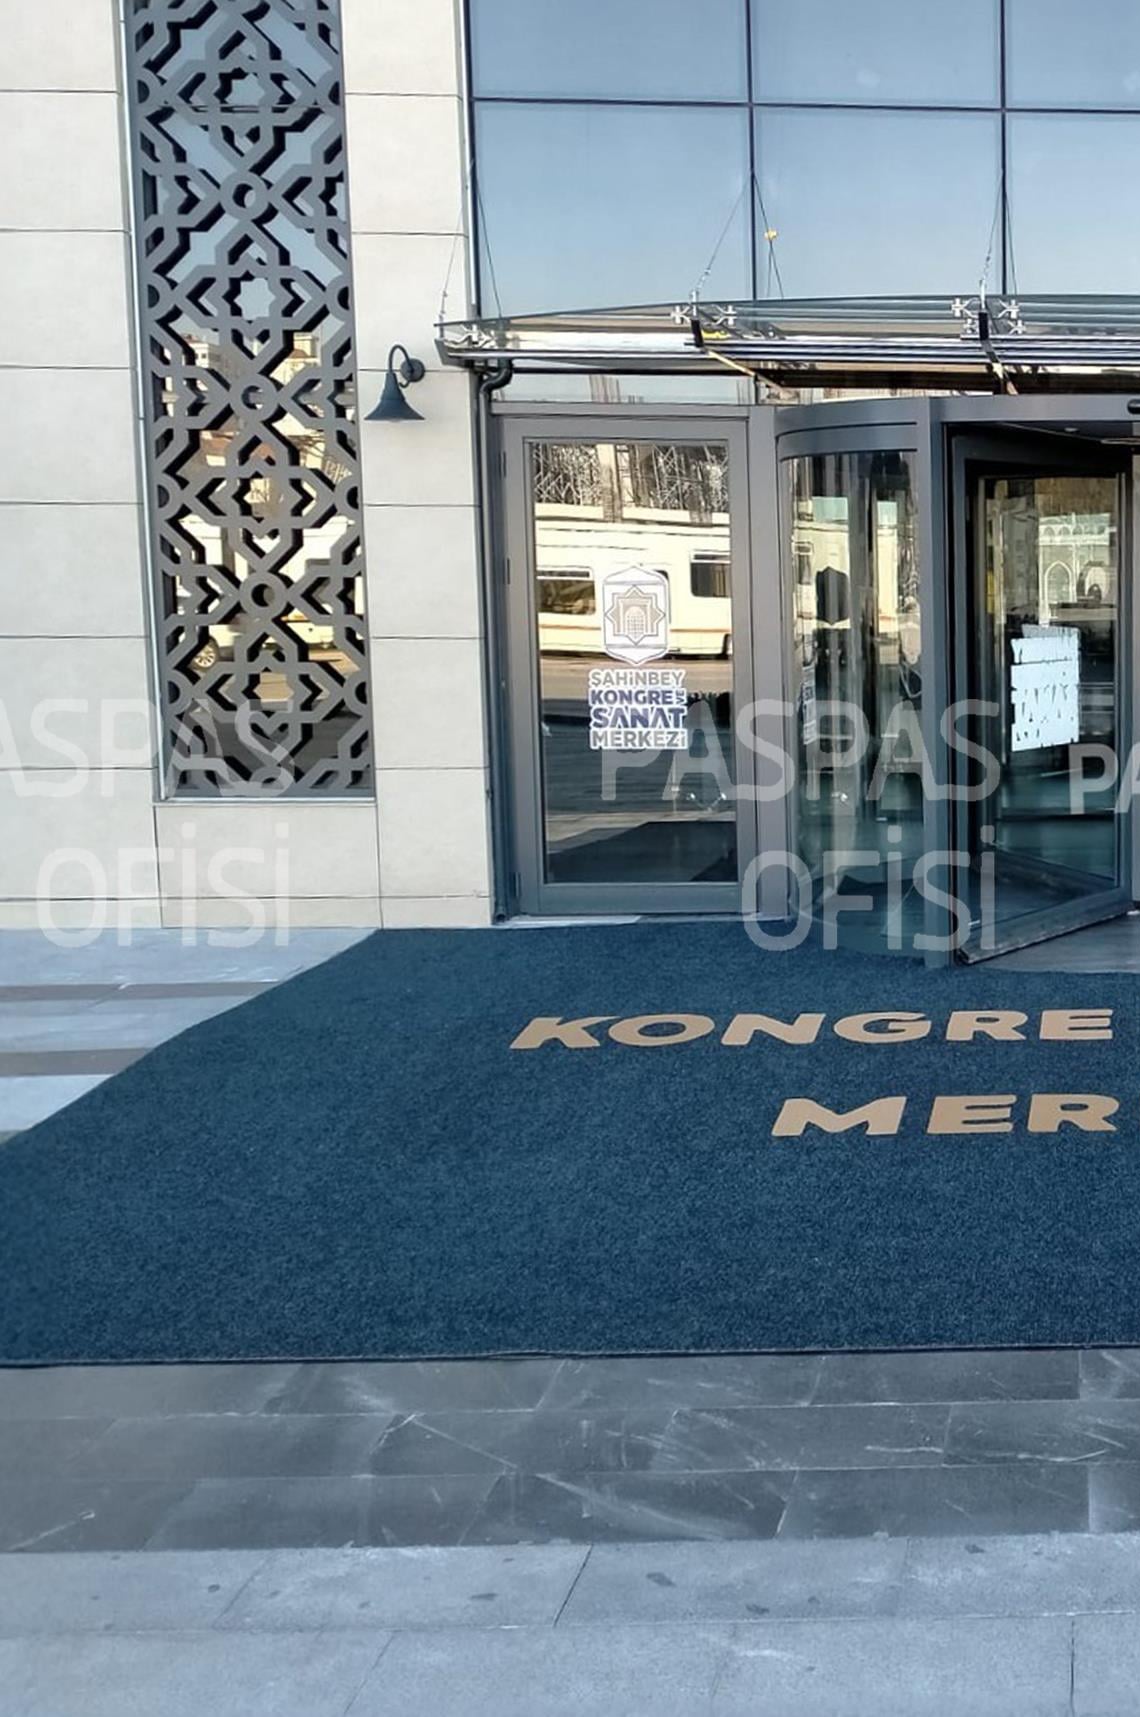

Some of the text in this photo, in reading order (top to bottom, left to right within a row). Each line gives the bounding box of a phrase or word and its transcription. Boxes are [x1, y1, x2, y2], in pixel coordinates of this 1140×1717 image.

[590, 689, 674, 706] KONGRE
[592, 707, 686, 730] SANAT
[510, 1008, 1114, 1049] KONGRE
